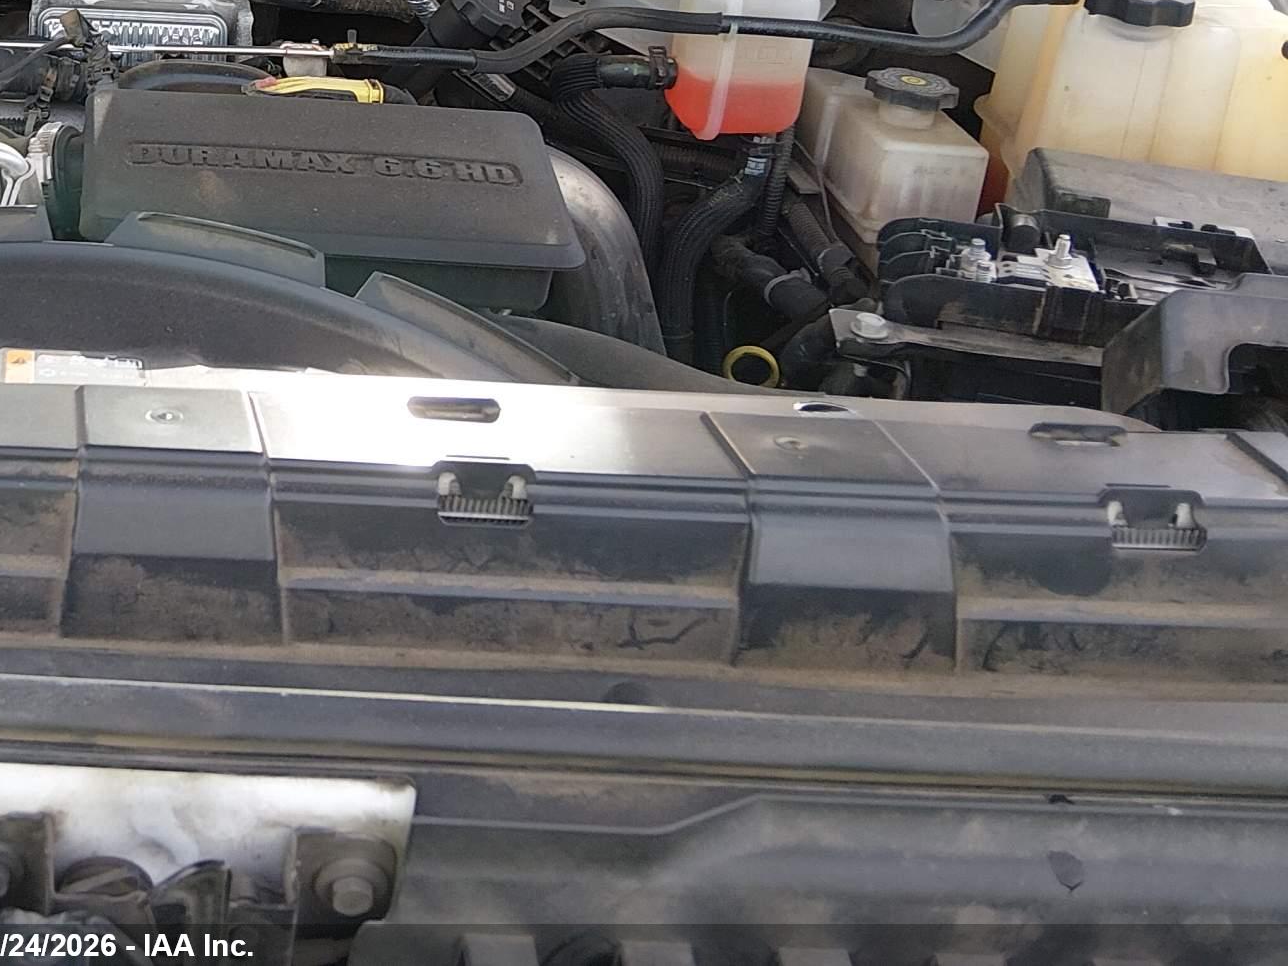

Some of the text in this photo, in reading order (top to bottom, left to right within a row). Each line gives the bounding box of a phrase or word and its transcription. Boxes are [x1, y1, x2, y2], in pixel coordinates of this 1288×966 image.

[129, 142, 517, 185] DURAMAX 6.6 HD
